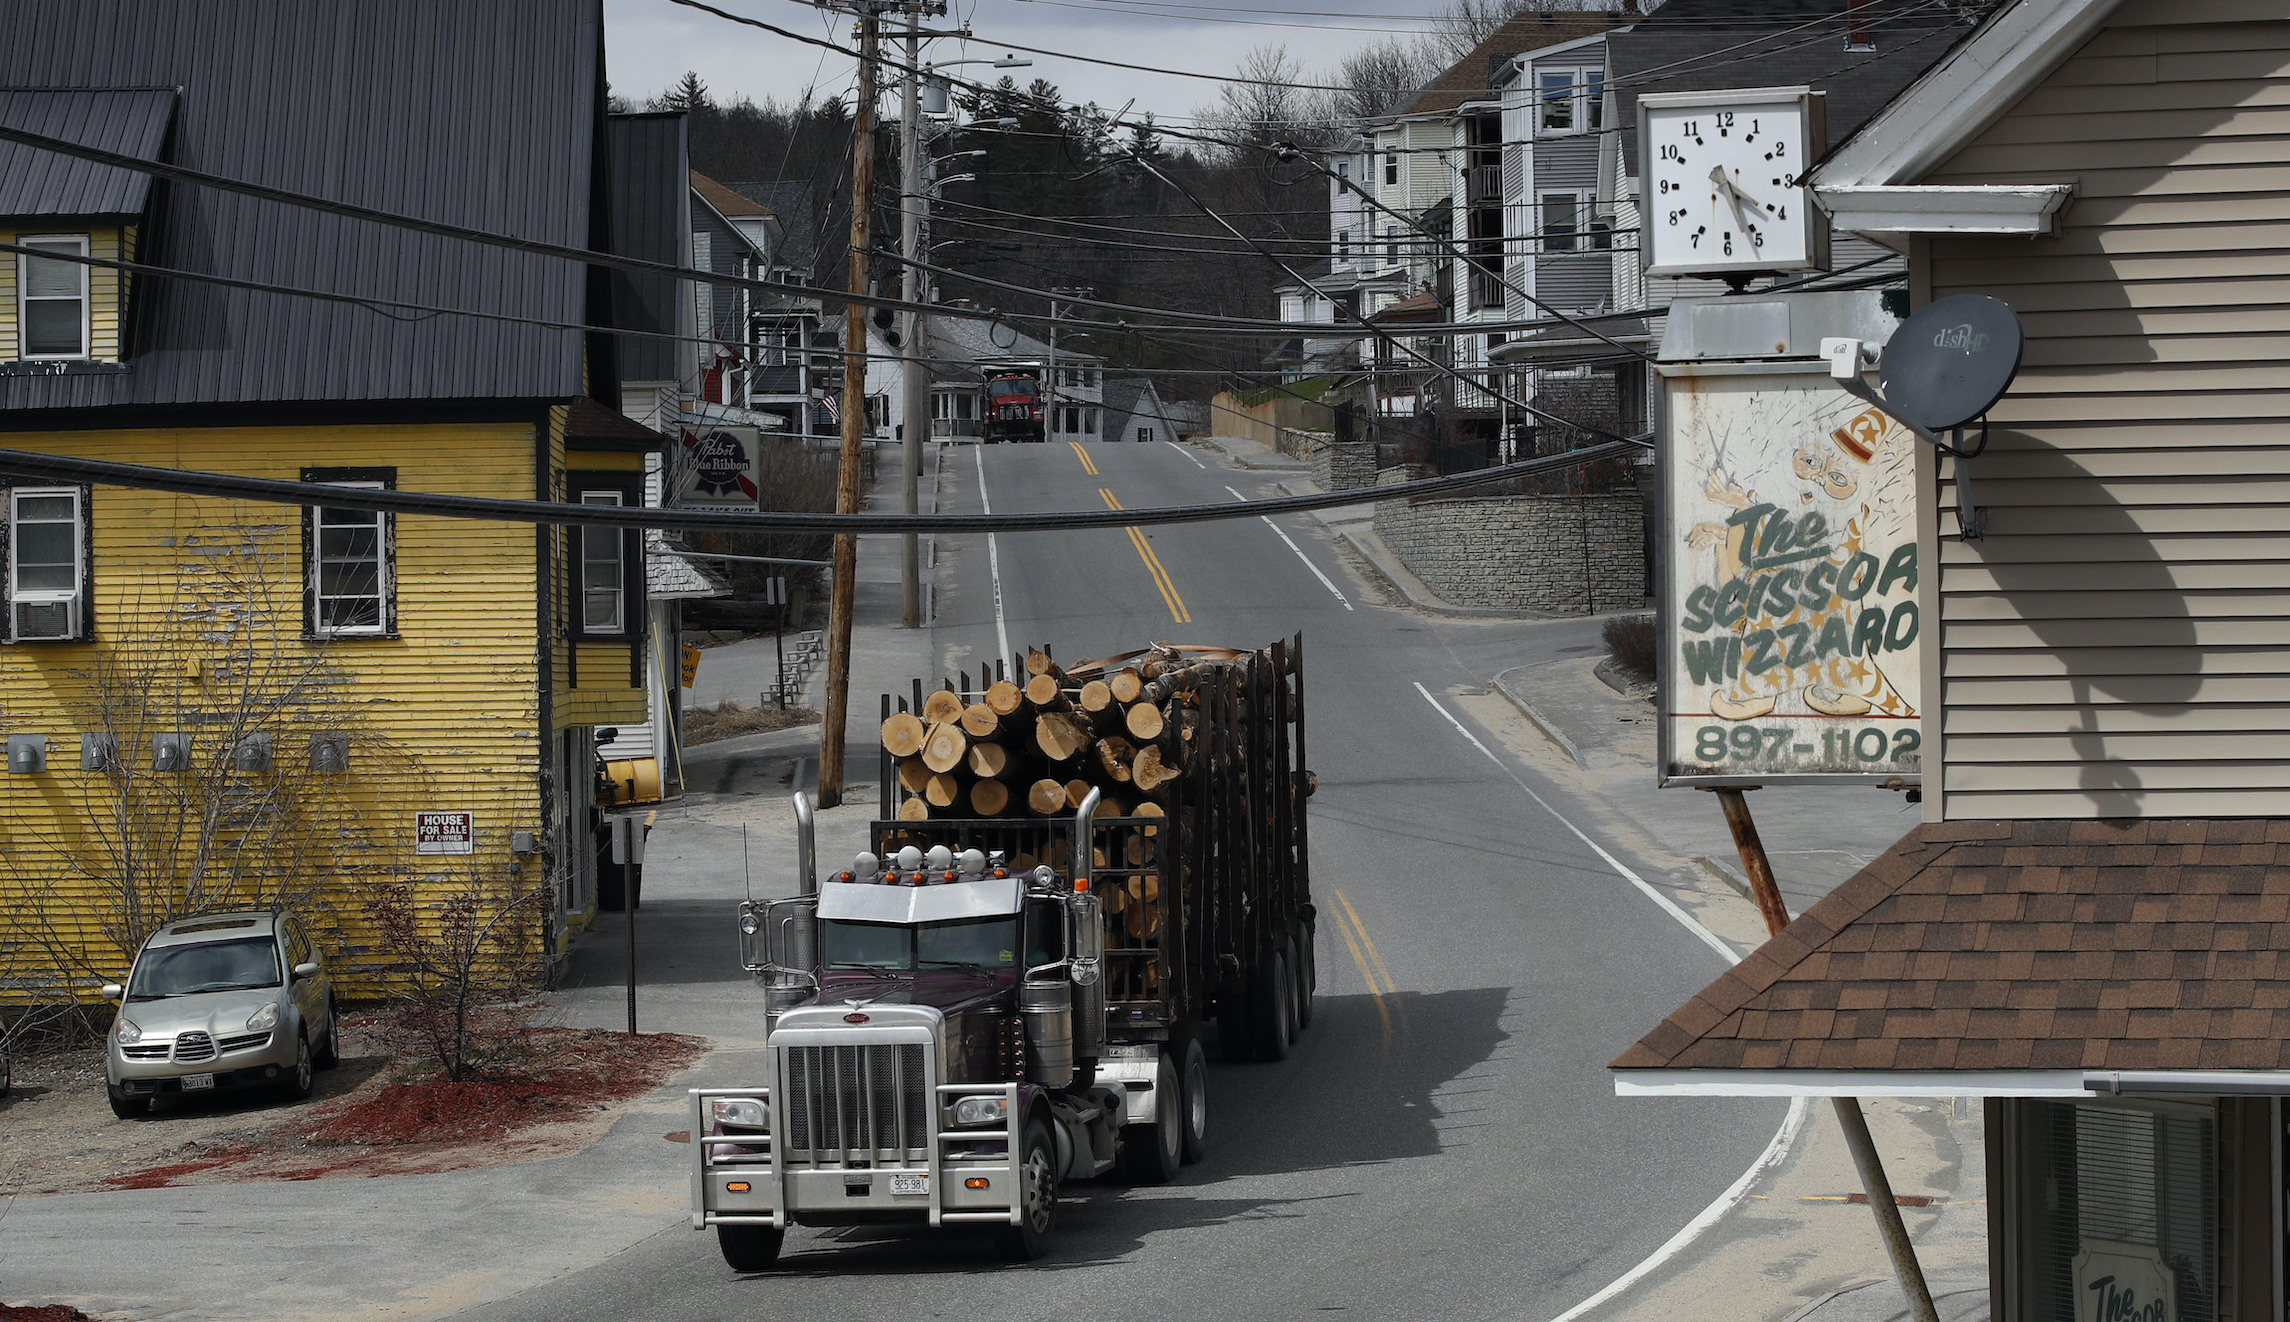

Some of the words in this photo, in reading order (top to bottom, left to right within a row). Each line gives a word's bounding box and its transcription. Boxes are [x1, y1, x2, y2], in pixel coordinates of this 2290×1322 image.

[1716, 112, 1734, 128] 12
[1752, 119, 1760, 134] 1
[1683, 121, 1699, 136] 11
[1660, 145, 1677, 160] 10
[1776, 142, 1785, 157] 2
[1660, 180, 1668, 194] 9
[1784, 174, 1793, 189] 3
[1669, 211, 1677, 226] 8
[1778, 205, 1786, 220] 4
[1691, 234, 1699, 249] 7
[1755, 233, 1763, 247] 5
[1724, 241, 1732, 256] 6
[701, 438, 736, 456] Pabst
[712, 458, 749, 470] Ribbon
[1725, 502, 1830, 567] The
[1682, 542, 1919, 633] SCISSOR
[1683, 601, 1919, 686] WIZZARD
[1695, 725, 1921, 762] 897-1102
[424, 815, 464, 825] HOUSE
[420, 825, 440, 835] FOR
[443, 825, 467, 835] SALE
[2088, 1275, 2134, 1322] The
